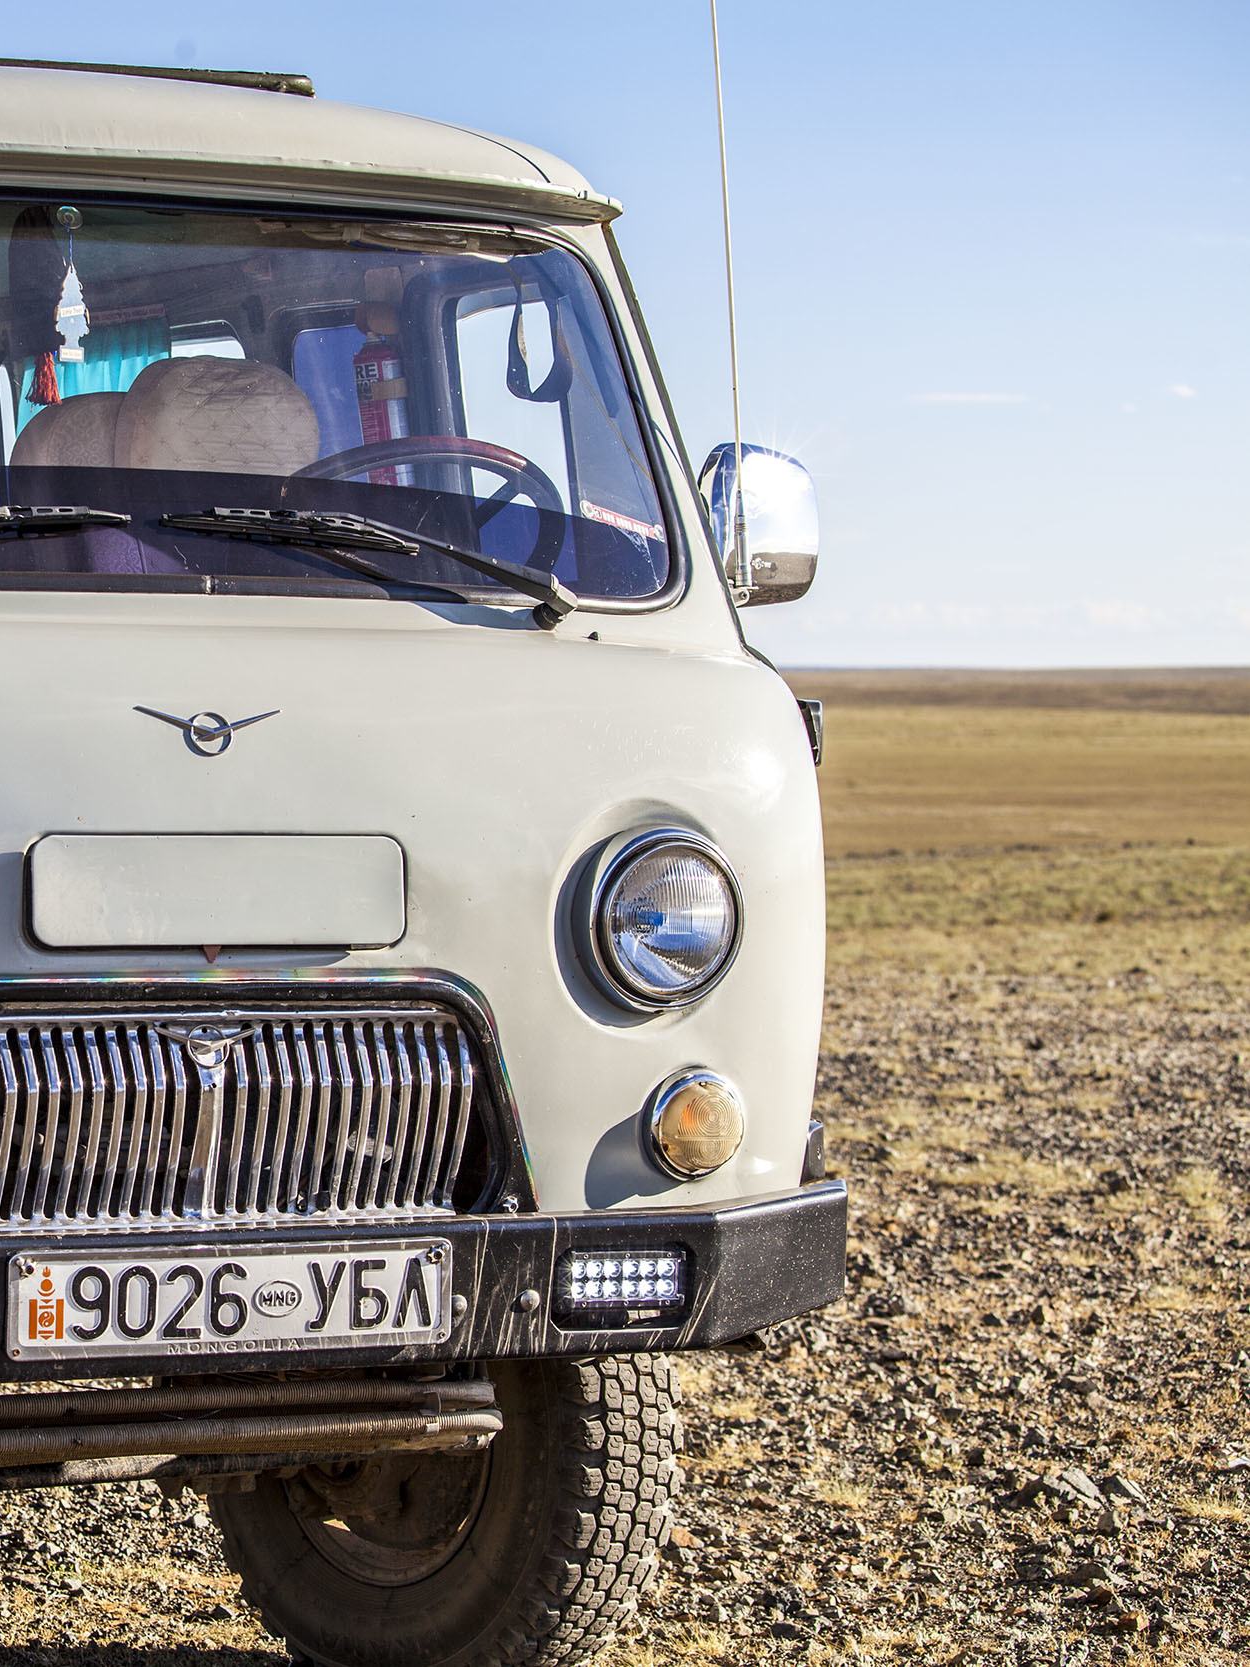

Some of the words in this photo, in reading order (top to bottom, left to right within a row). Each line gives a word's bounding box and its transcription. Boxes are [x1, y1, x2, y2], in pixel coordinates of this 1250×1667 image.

[355, 363, 377, 379] RE
[70, 1262, 248, 1341] 9026
[258, 1290, 296, 1307] MNG
[308, 1257, 432, 1332] УБЛ
[167, 1339, 303, 1355] MONGOLIA
